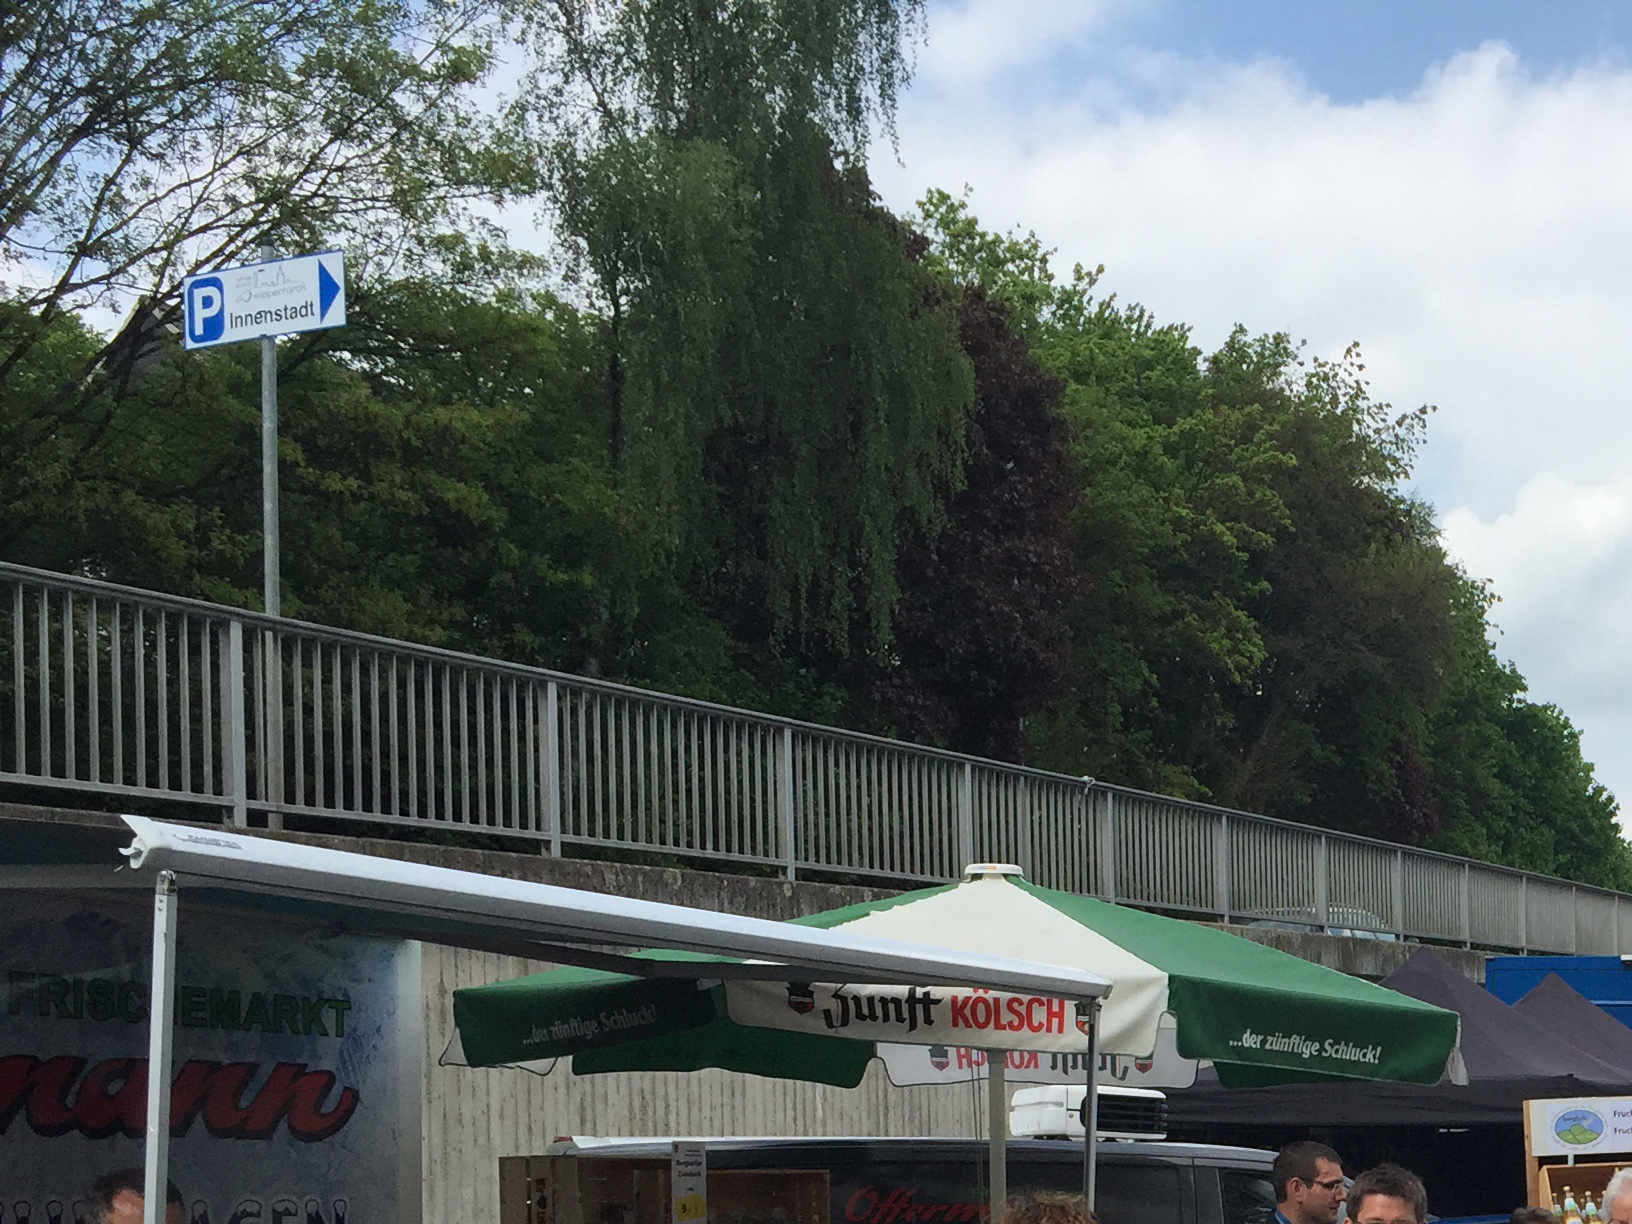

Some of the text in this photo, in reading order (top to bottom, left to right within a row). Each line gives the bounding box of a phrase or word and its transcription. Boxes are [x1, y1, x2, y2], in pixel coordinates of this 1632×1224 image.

[229, 301, 315, 329] Innenstadt
[8, 969, 351, 1038] FRISCEMARKT
[950, 986, 1065, 1034] KÖLSCH
[1264, 1032, 1320, 1058] zünftige
[1322, 1038, 1382, 1064] Schluck!
